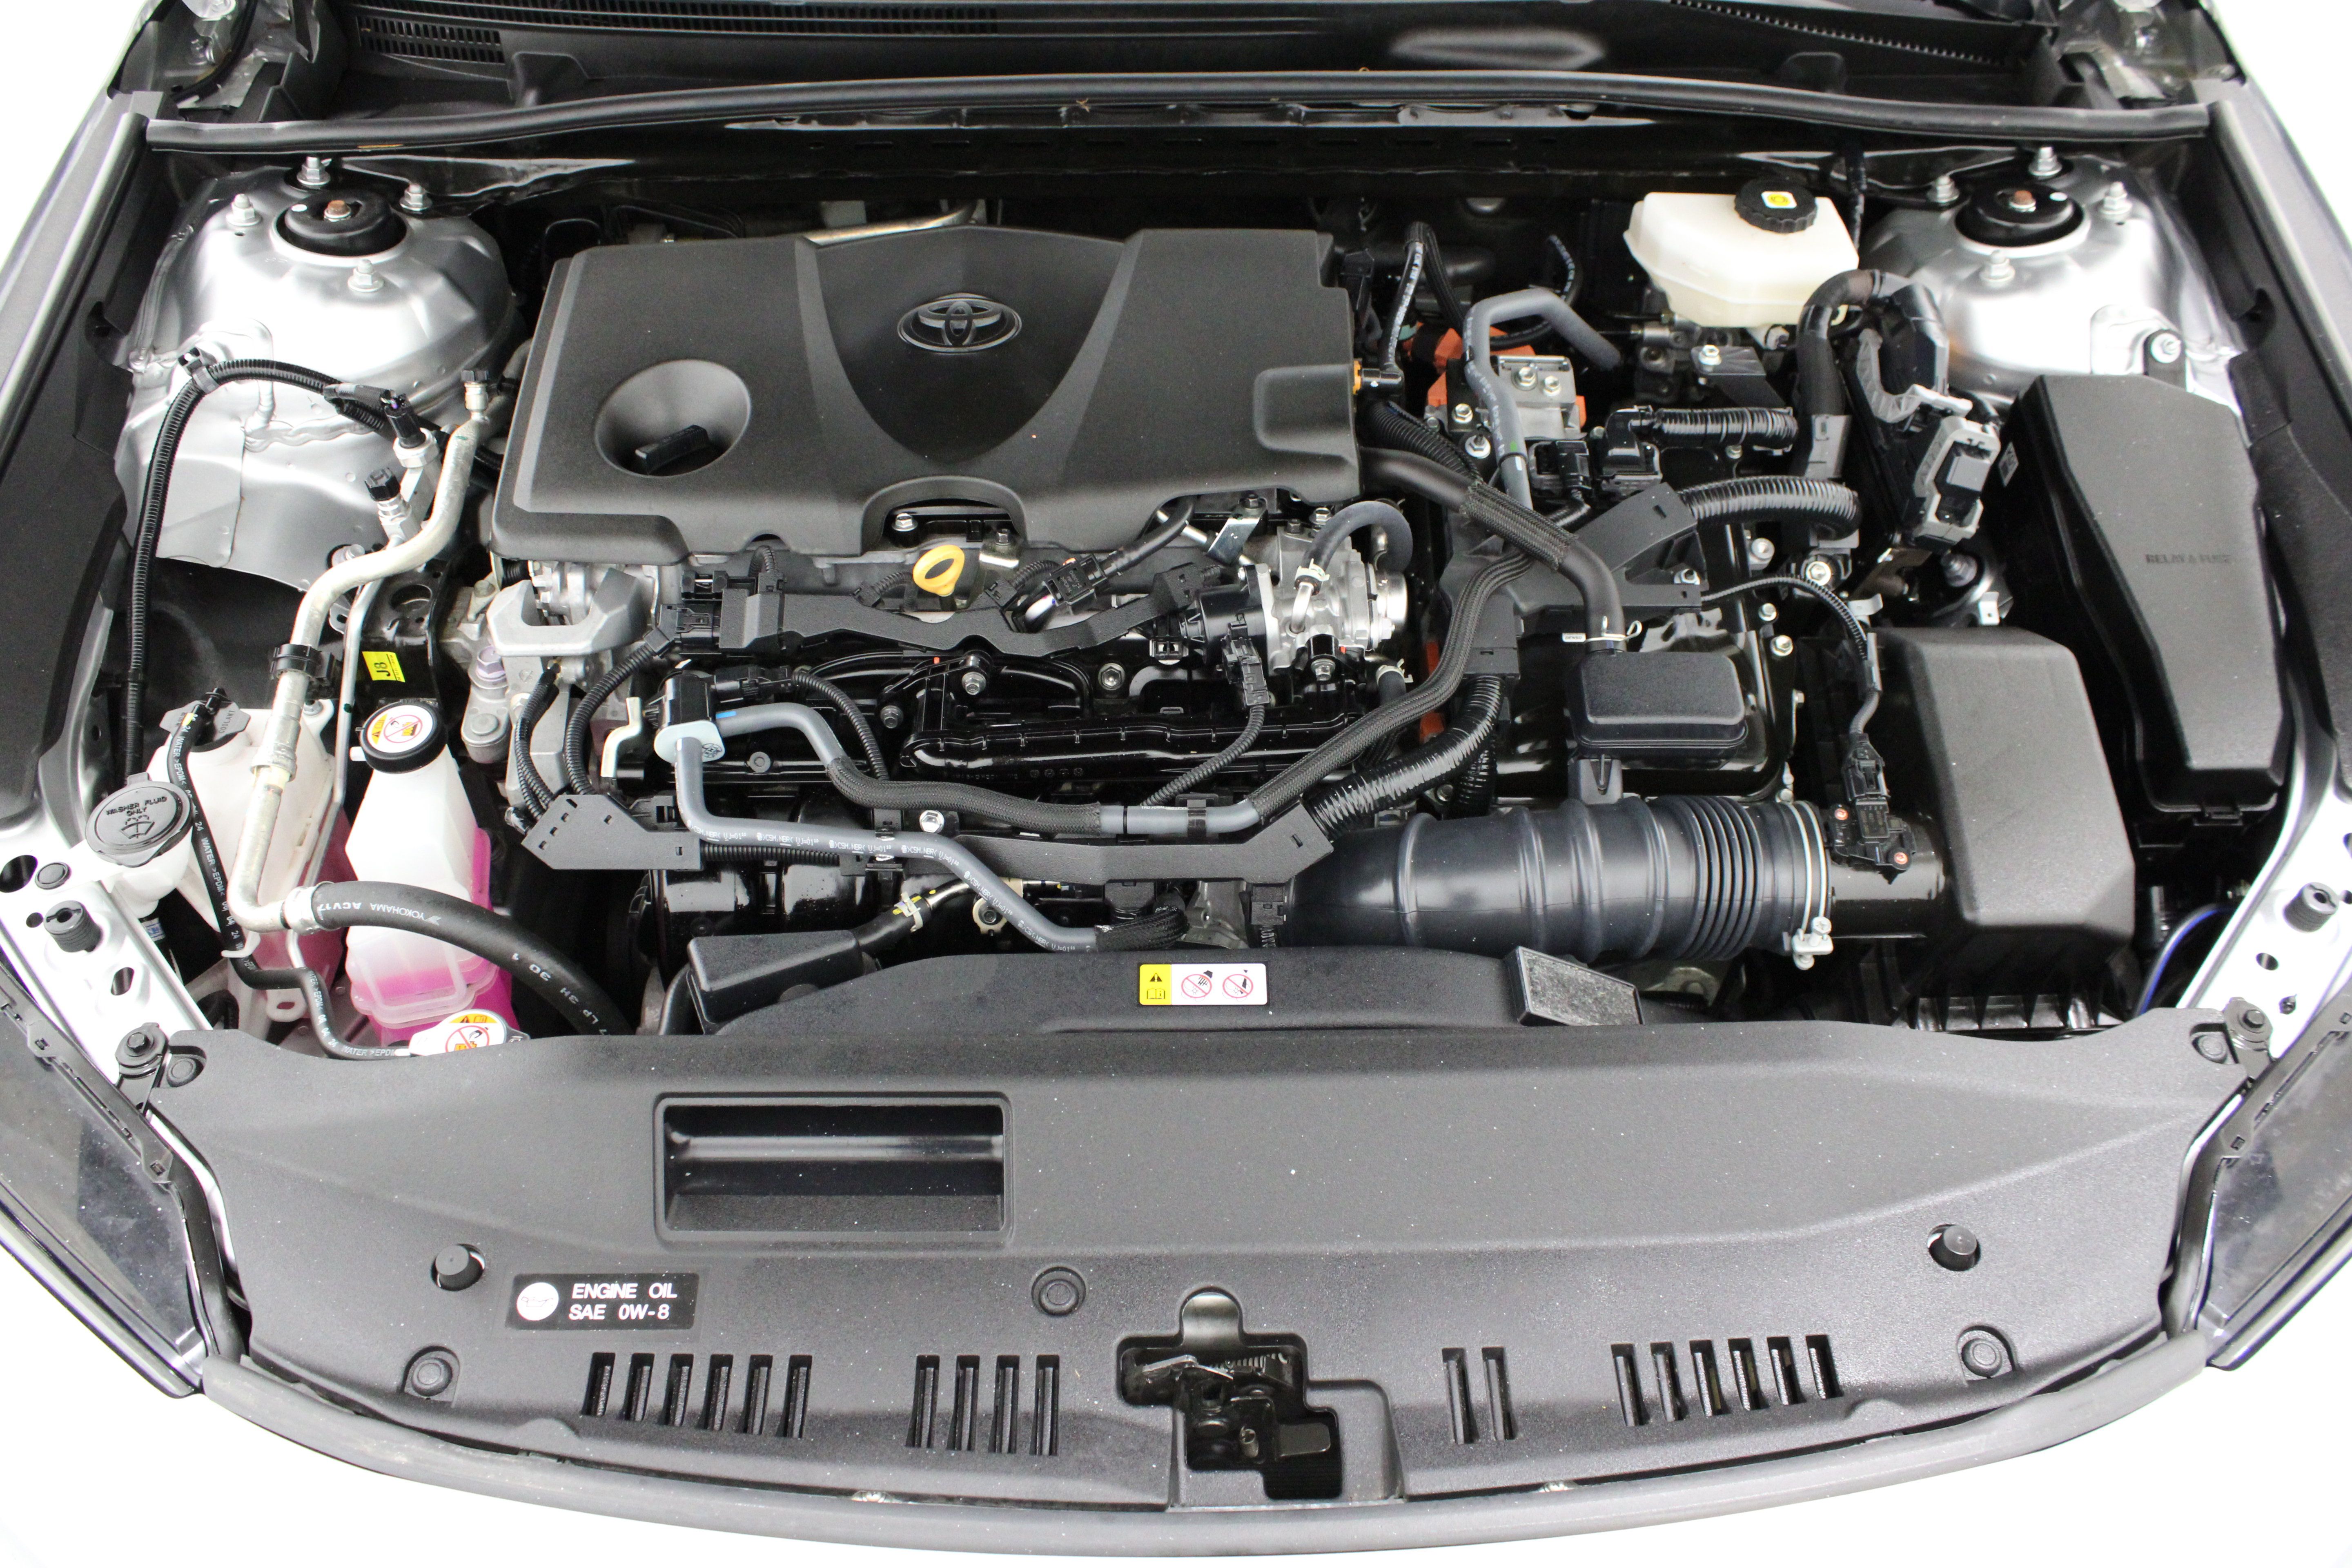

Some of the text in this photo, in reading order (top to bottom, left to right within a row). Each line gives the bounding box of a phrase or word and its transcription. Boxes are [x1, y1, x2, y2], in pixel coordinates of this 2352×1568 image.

[374, 662, 391, 677] J8
[181, 725, 191, 733] 24
[218, 710, 235, 734] COOLANT
[173, 736, 186, 757] WATER
[106, 796, 167, 815] WASHER FLUID
[126, 806, 147, 816] ONLY
[195, 821, 204, 832] 24
[201, 837, 216, 866] WATER
[231, 930, 240, 939] 24
[370, 902, 425, 920] YOKOHAMA
[341, 1045, 368, 1057] WATER
[572, 1283, 677, 1299] ENGINE OIL
[568, 1303, 670, 1321] SAE 0W-8
